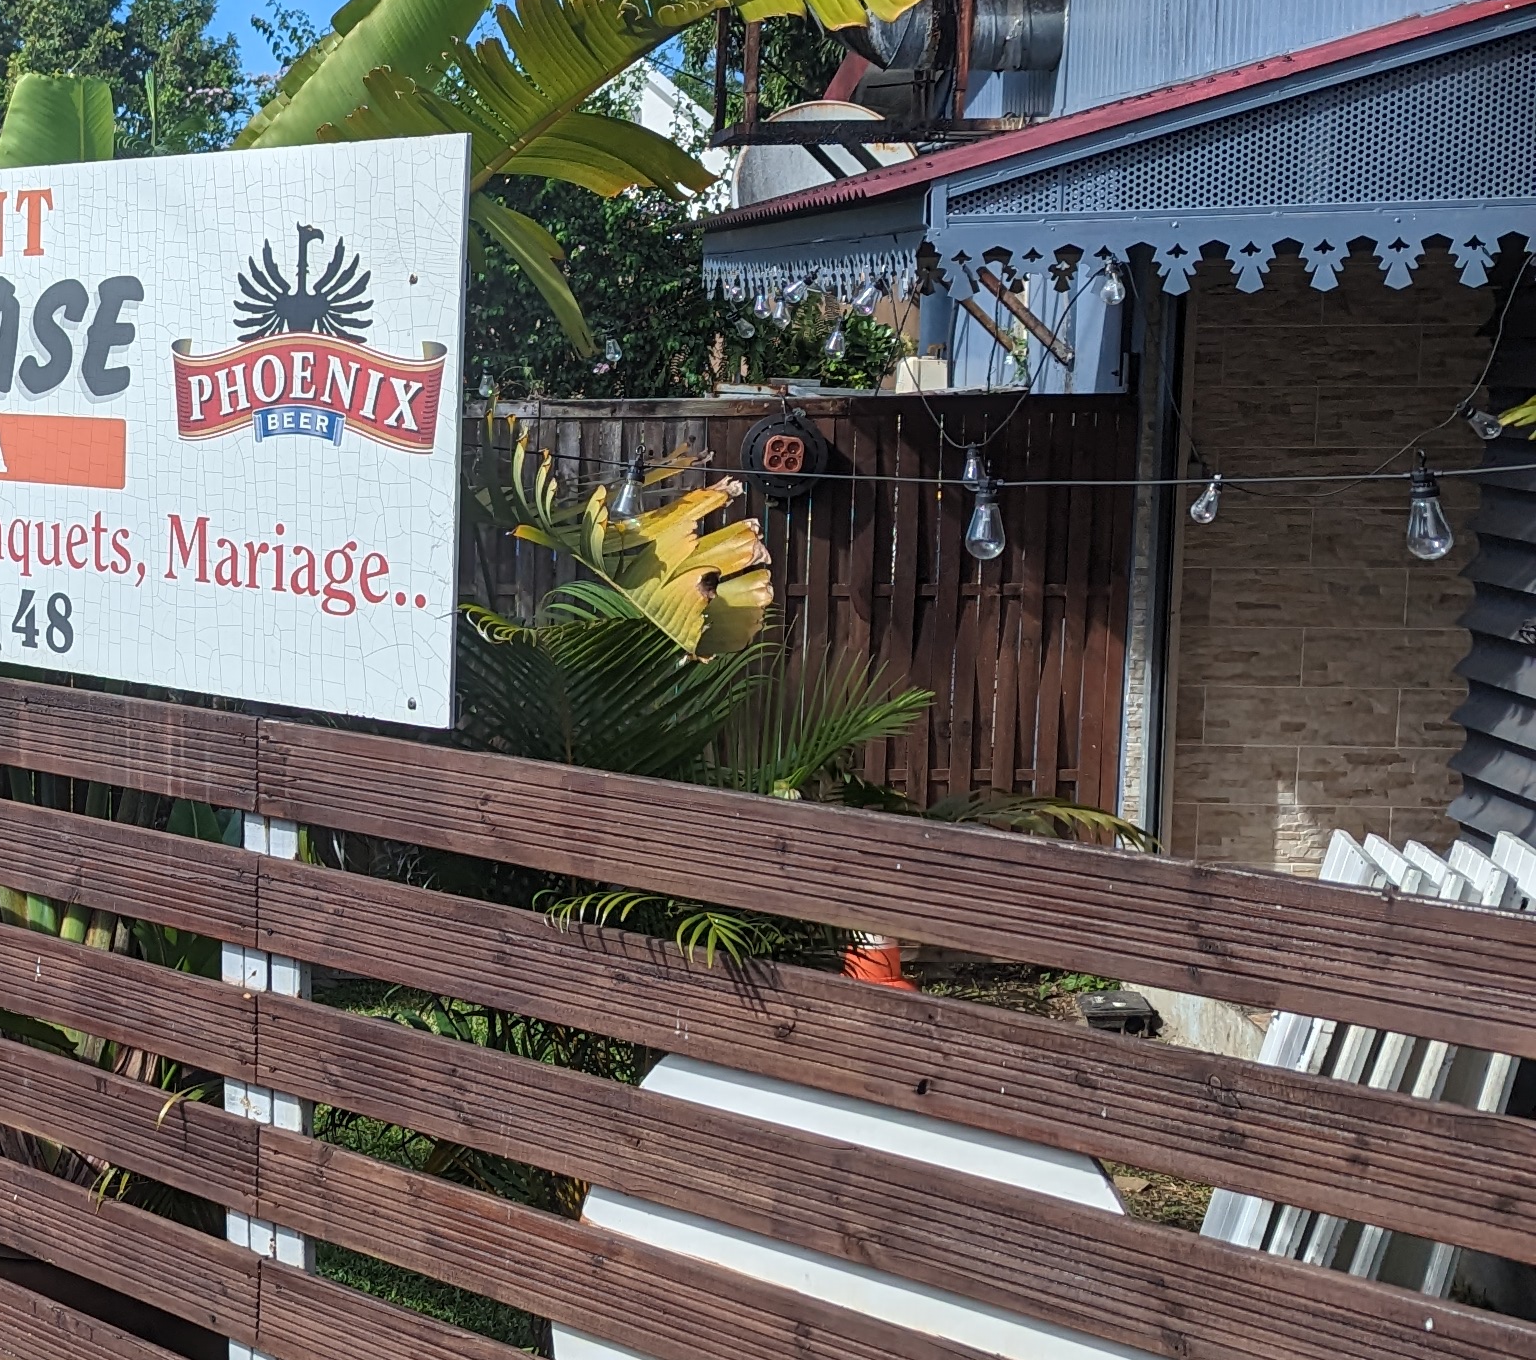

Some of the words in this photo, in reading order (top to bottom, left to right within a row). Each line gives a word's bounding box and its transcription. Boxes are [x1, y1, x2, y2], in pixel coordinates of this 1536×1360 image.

[189, 350, 424, 433] PHOENIX
[266, 413, 330, 434] BEER
[11, 589, 75, 654] 48
